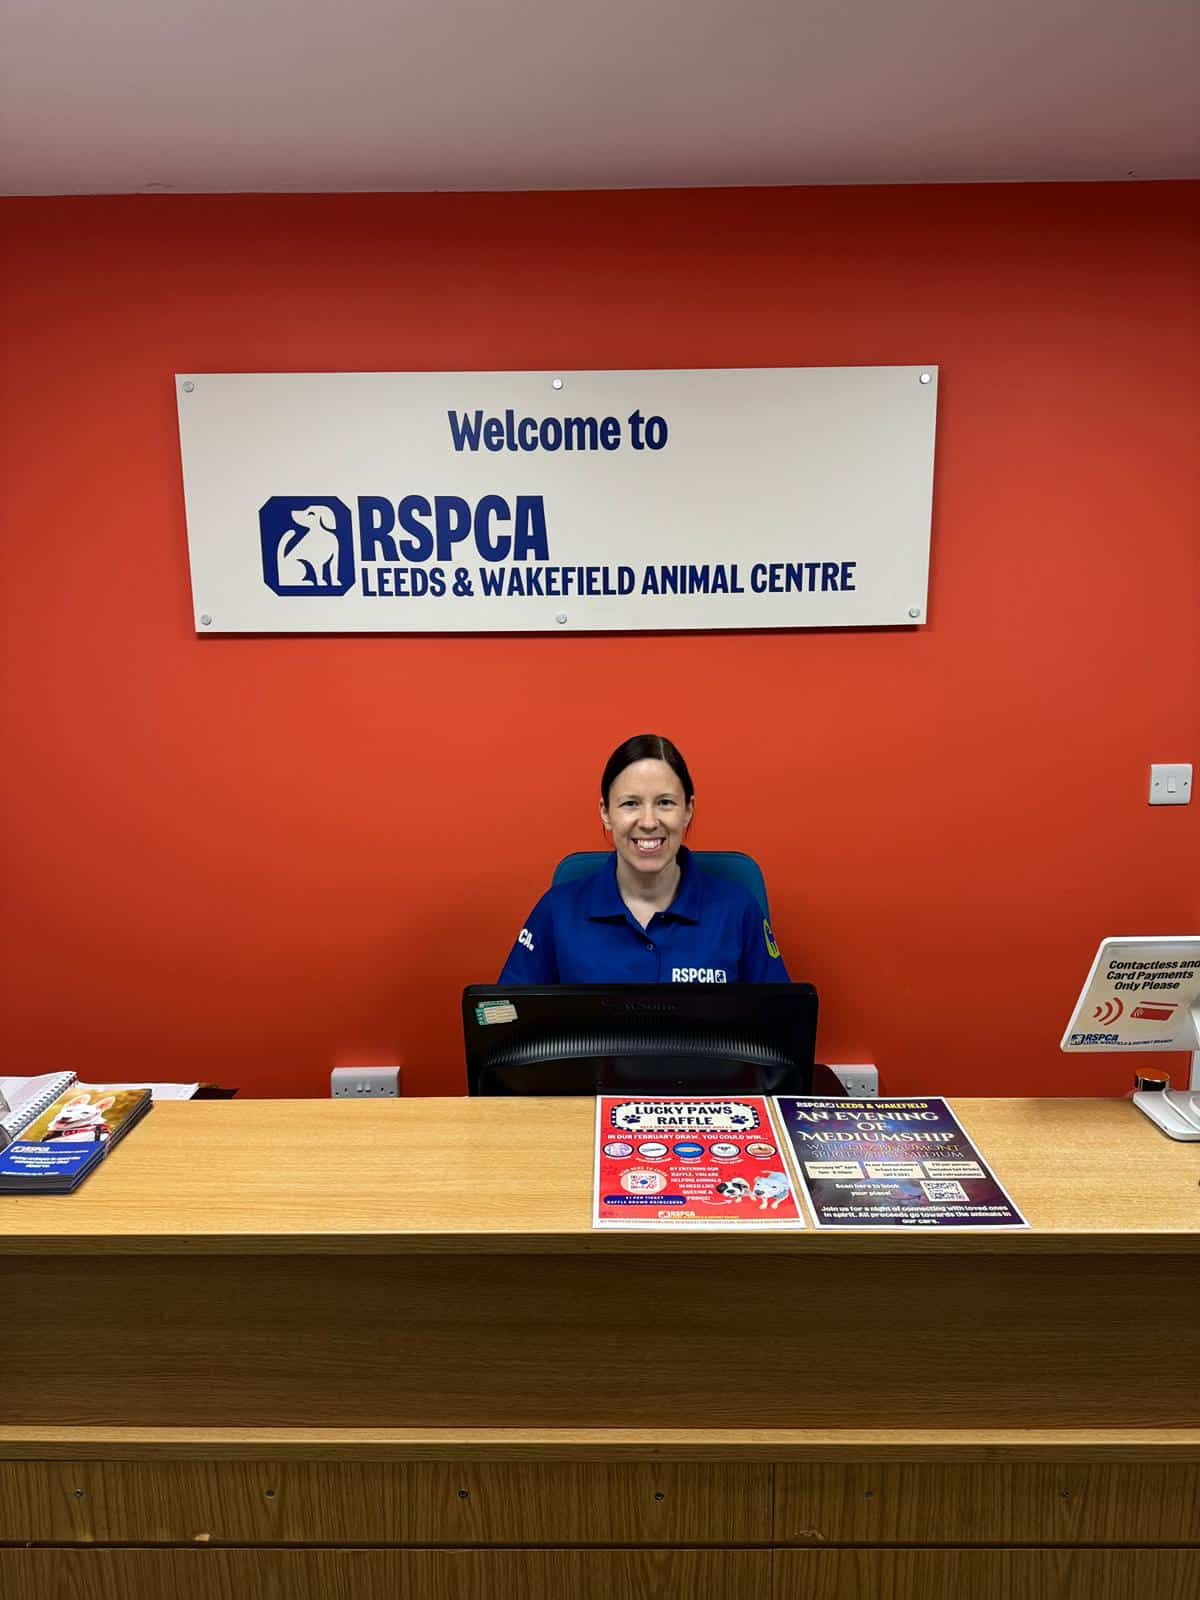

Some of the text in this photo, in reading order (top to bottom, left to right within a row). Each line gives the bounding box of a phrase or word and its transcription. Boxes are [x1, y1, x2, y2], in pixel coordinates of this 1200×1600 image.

[447, 409, 668, 452] Welcome to
[357, 495, 549, 562] RSPCA
[361, 562, 856, 597] LEEDS & WAKEFIELD ANIMAL CENTRE
[1109, 960, 1178, 970] Contactless
[672, 968, 714, 983] RSPCA
[1106, 970, 1194, 982] Card Payments
[1114, 981, 1180, 991] Only Please
[635, 1106, 732, 1115] LUCKY PAWS
[656, 1116, 714, 1125] RAFFLE
[796, 1110, 939, 1123] AN EVENING
[856, 1122, 889, 1131] OF
[797, 1131, 955, 1142] MEDIUMSHIP
